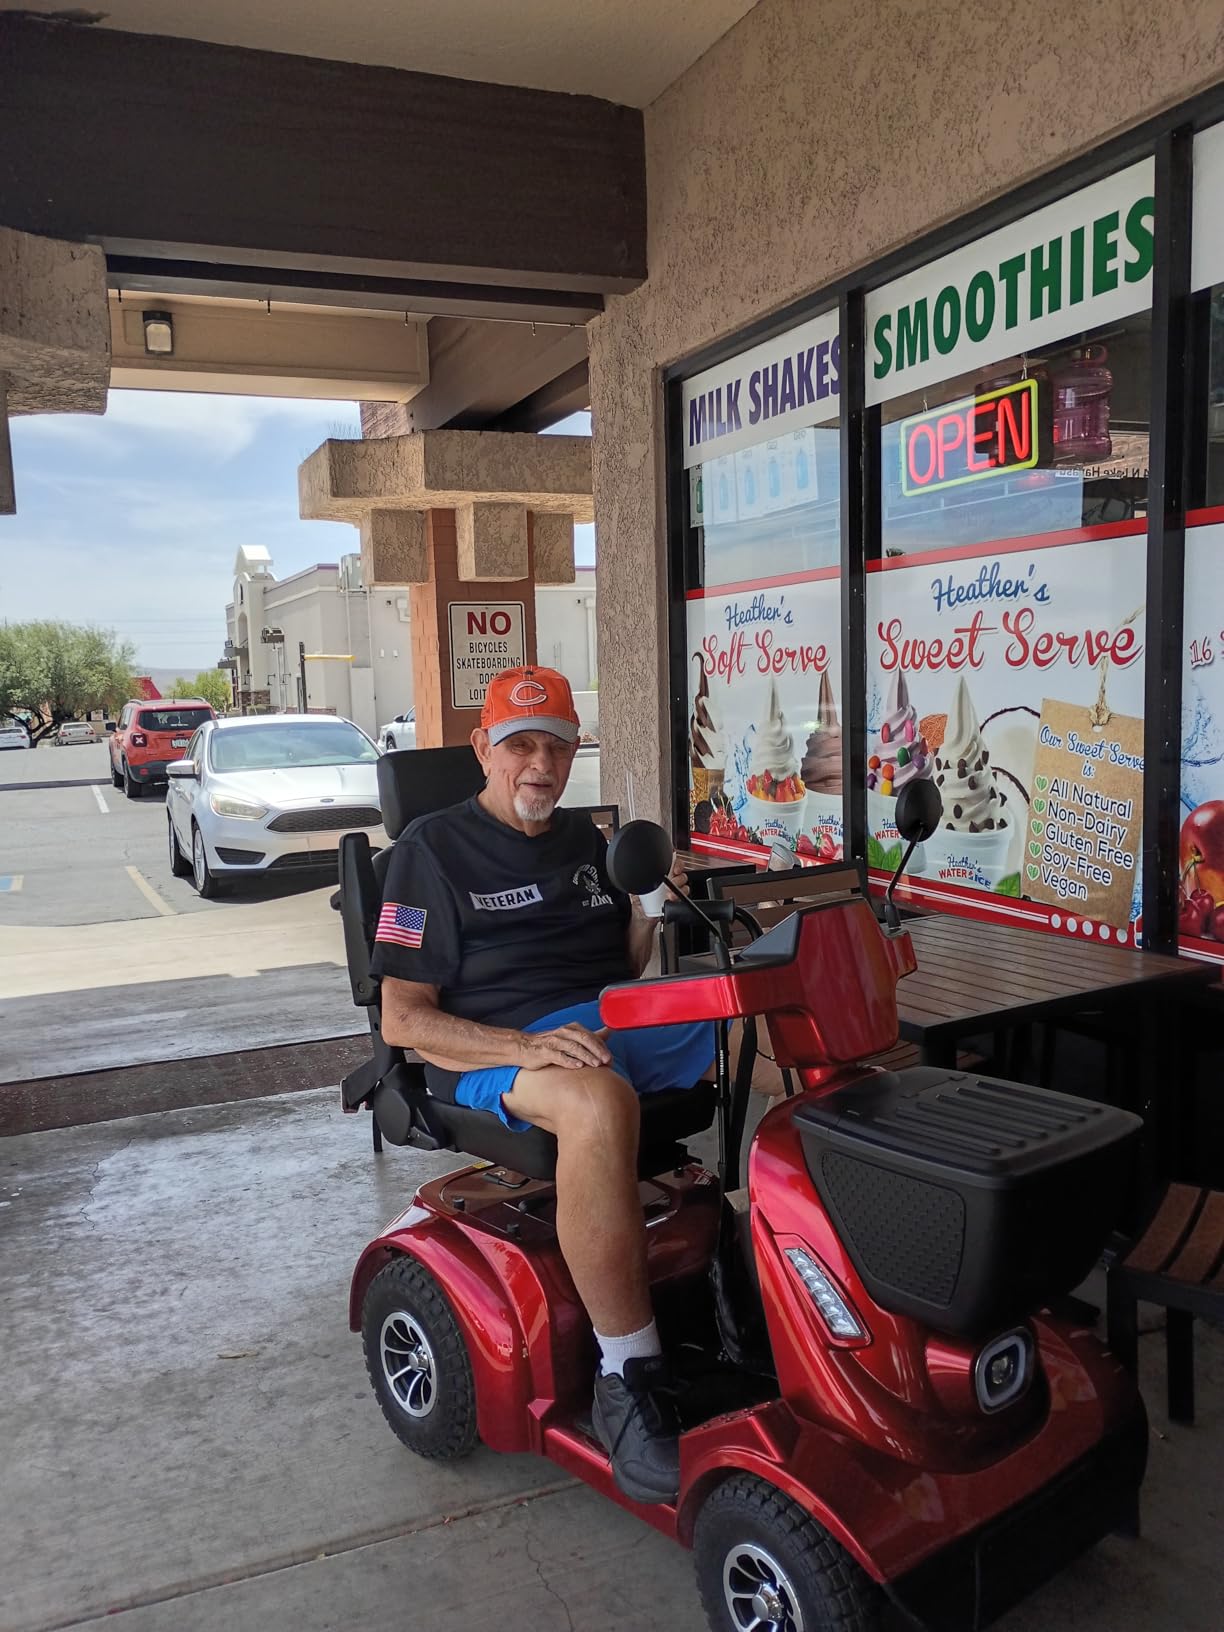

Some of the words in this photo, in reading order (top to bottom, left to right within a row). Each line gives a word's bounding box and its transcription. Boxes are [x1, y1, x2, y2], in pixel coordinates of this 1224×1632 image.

[873, 196, 1154, 379] SMOOTHIES
[689, 378, 742, 447] MILK
[749, 334, 840, 425] SHAKES
[909, 391, 1029, 484] OPEN
[931, 562, 1050, 612] Heather's
[467, 611, 512, 635] NO
[725, 594, 793, 631] Heather's
[469, 641, 508, 653] BICYCLES
[878, 610, 998, 670] Sweet
[1002, 608, 1143, 667] Serve
[1190, 636, 1212, 665] 16
[457, 657, 520, 669] SKATEBOARDING
[703, 631, 752, 684] Soft
[755, 629, 830, 673] Serve
[509, 680, 547, 706] C
[1040, 725, 1063, 748] Our
[1067, 731, 1108, 760] Sweet
[1109, 743, 1144, 771] Serve
[1083, 760, 1095, 777] is:
[1049, 778, 1069, 799] All
[1072, 784, 1132, 819] Natural
[760, 828, 778, 837] WATER
[812, 825, 833, 835] WATER
[875, 829, 899, 840] WATER
[1048, 800, 1126, 845] Non-Dairy
[1046, 823, 1093, 855] Gluten
[1097, 841, 1133, 868] Free
[939, 868, 967, 879] WATER
[974, 874, 991, 889] ICE
[947, 854, 982, 873] Heather's
[1043, 845, 1111, 884] Soy-Free
[475, 889, 535, 908] VETERAN
[1041, 866, 1087, 899] Vegan
